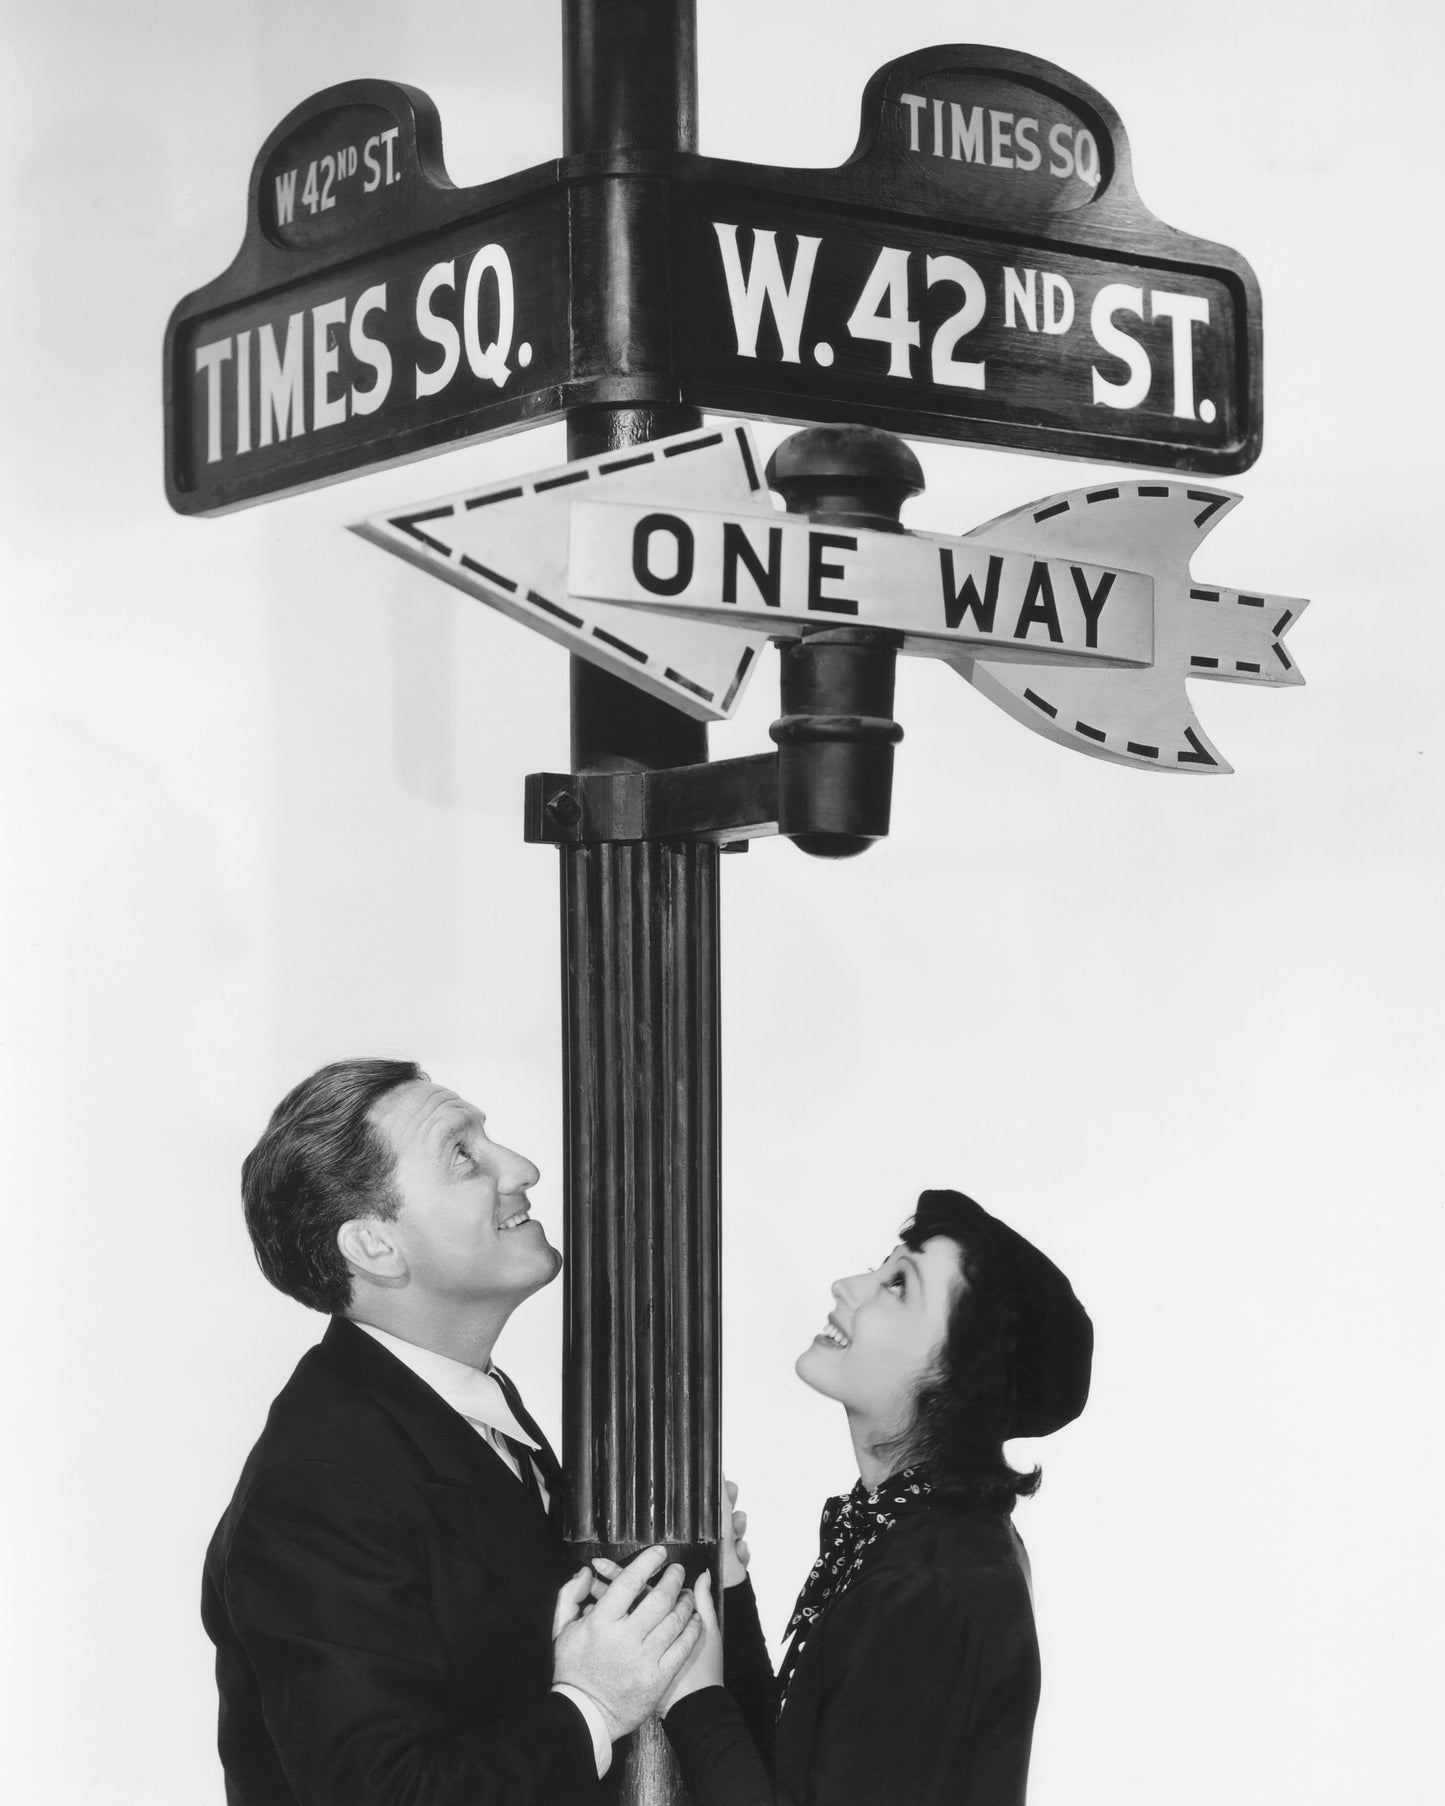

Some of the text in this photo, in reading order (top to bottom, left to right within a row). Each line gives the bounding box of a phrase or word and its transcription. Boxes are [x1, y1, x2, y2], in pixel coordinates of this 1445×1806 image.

[363, 127, 401, 193] ST.
[901, 93, 1041, 171] TIMES
[195, 243, 533, 464] TIMES SQ.
[712, 222, 1216, 423] W. 42ND ST.
[632, 513, 1117, 648] ONE WAY
